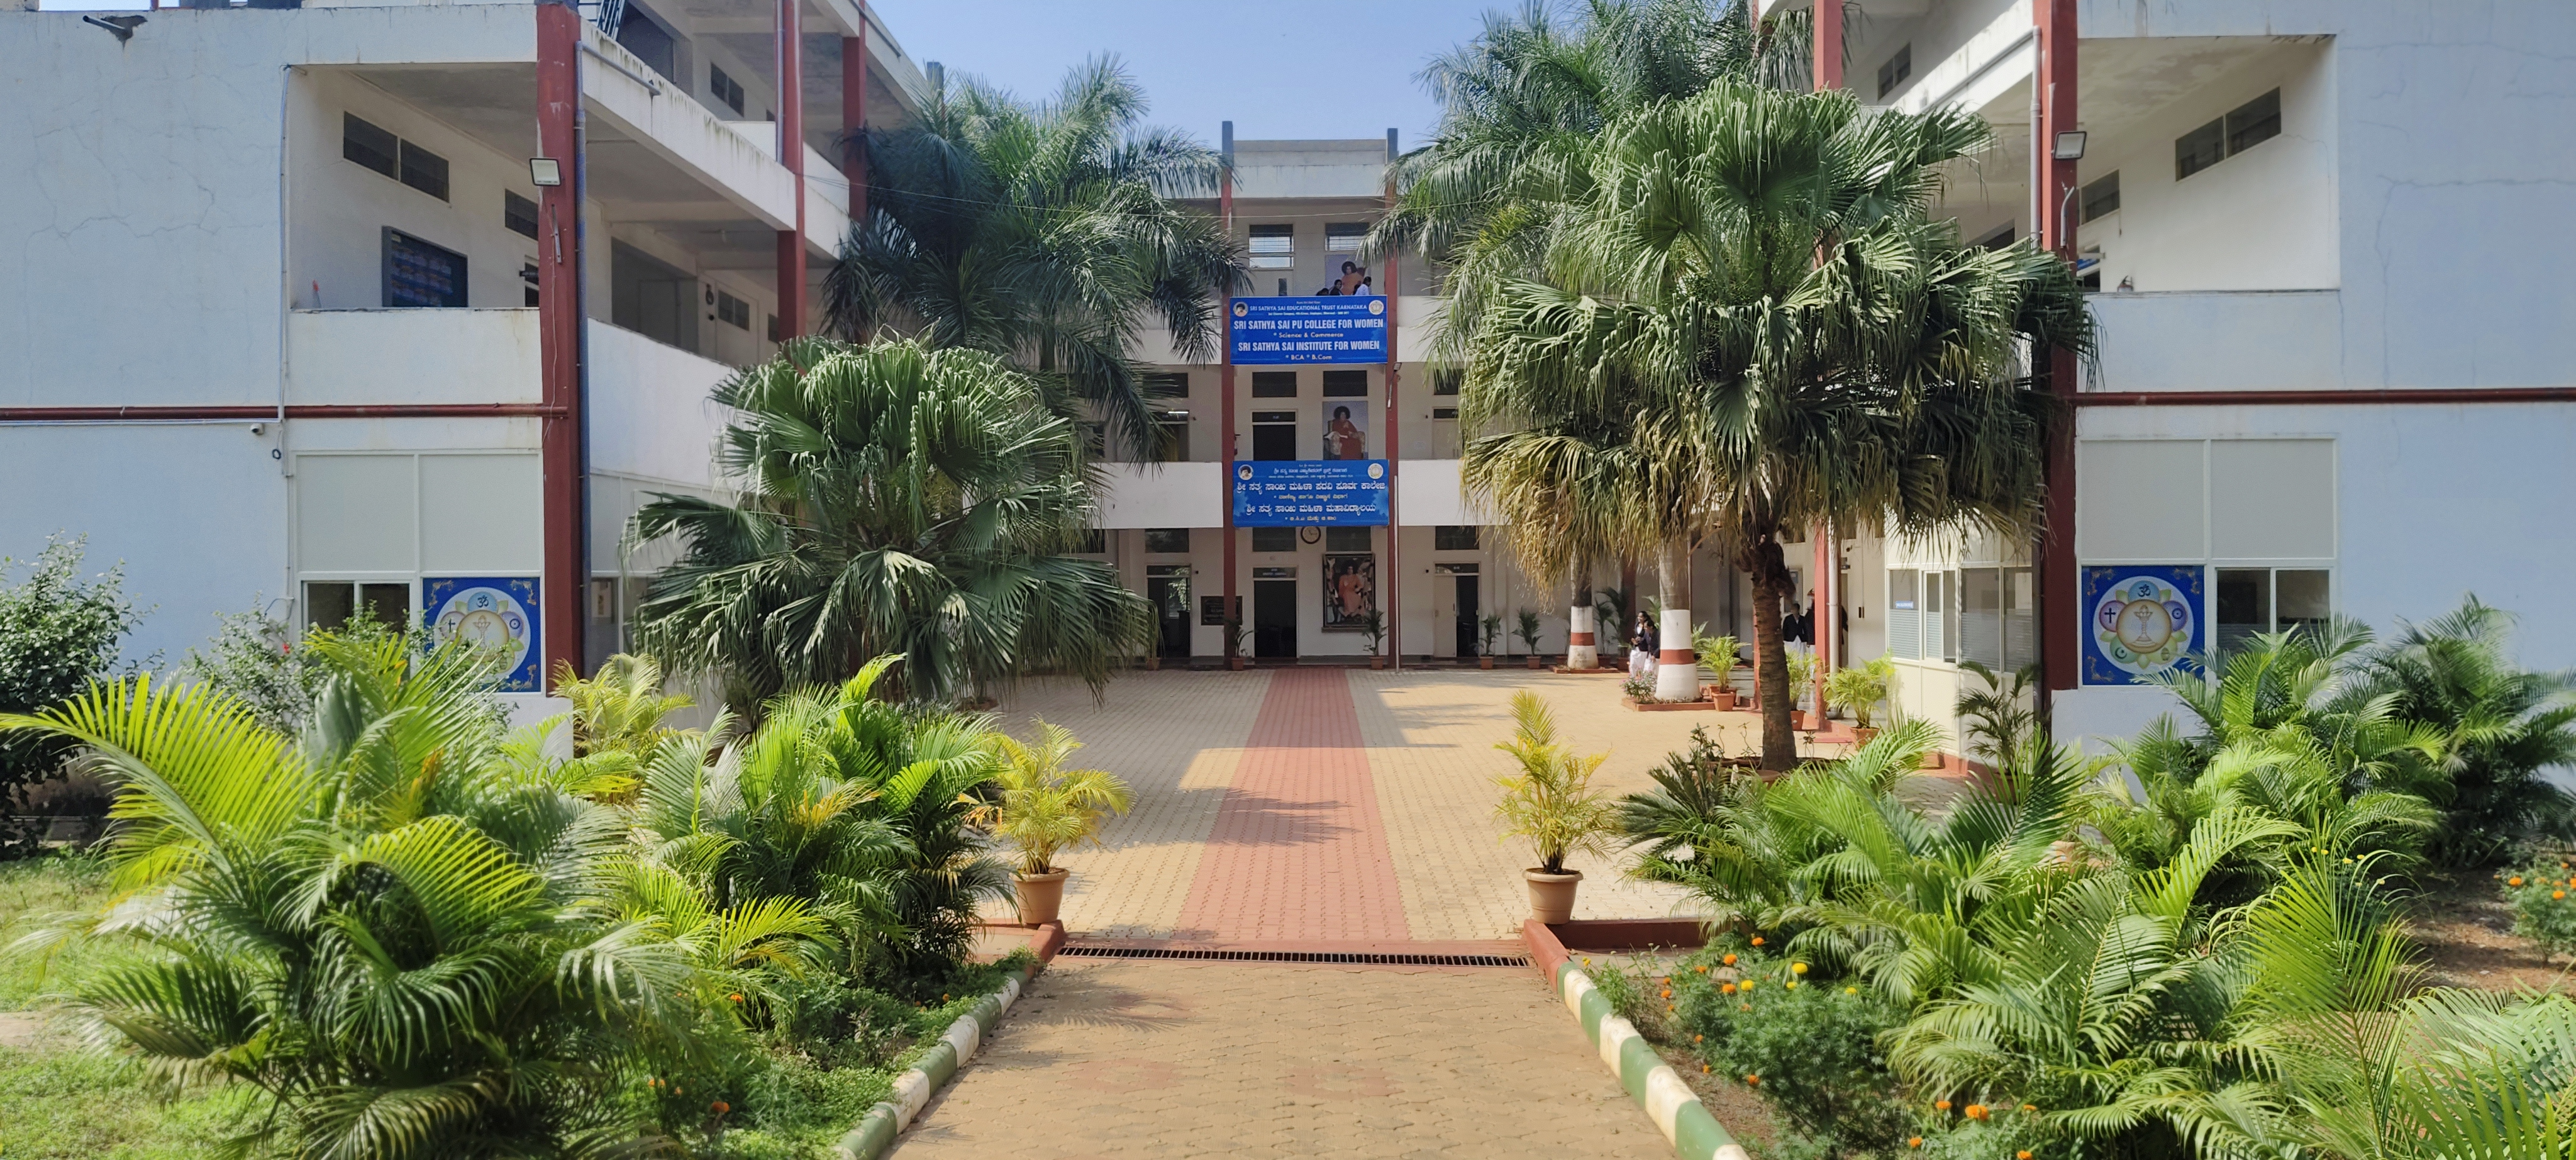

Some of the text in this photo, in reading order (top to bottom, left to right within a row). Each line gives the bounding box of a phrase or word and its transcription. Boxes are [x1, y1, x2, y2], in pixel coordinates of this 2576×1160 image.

[1233, 318, 1384, 330] SRI SATHYA SAI PU COLLEGE FOR WOMEN
[1238, 340, 1380, 352] SRI SATHYA SAI INSTITUTE FOR WOMEN
[1236, 482, 1246, 493] ಶ್ರೀ
[1249, 482, 1262, 495] ಸತ್ಯ
[1289, 481, 1313, 491] ಮಹಿಳಾ
[1316, 481, 1333, 490] ಪದವಿ
[1336, 481, 1358, 490] ಪೂರ್ವ
[1246, 504, 1255, 515] ಶ್ರೀ
[1258, 503, 1272, 516] ಸತ್ಯ
[1299, 503, 1323, 512] ಮಹಿಳಾ
[1326, 503, 1376, 516] ಮಹಾವಿದ್ಯಾಲಯ
